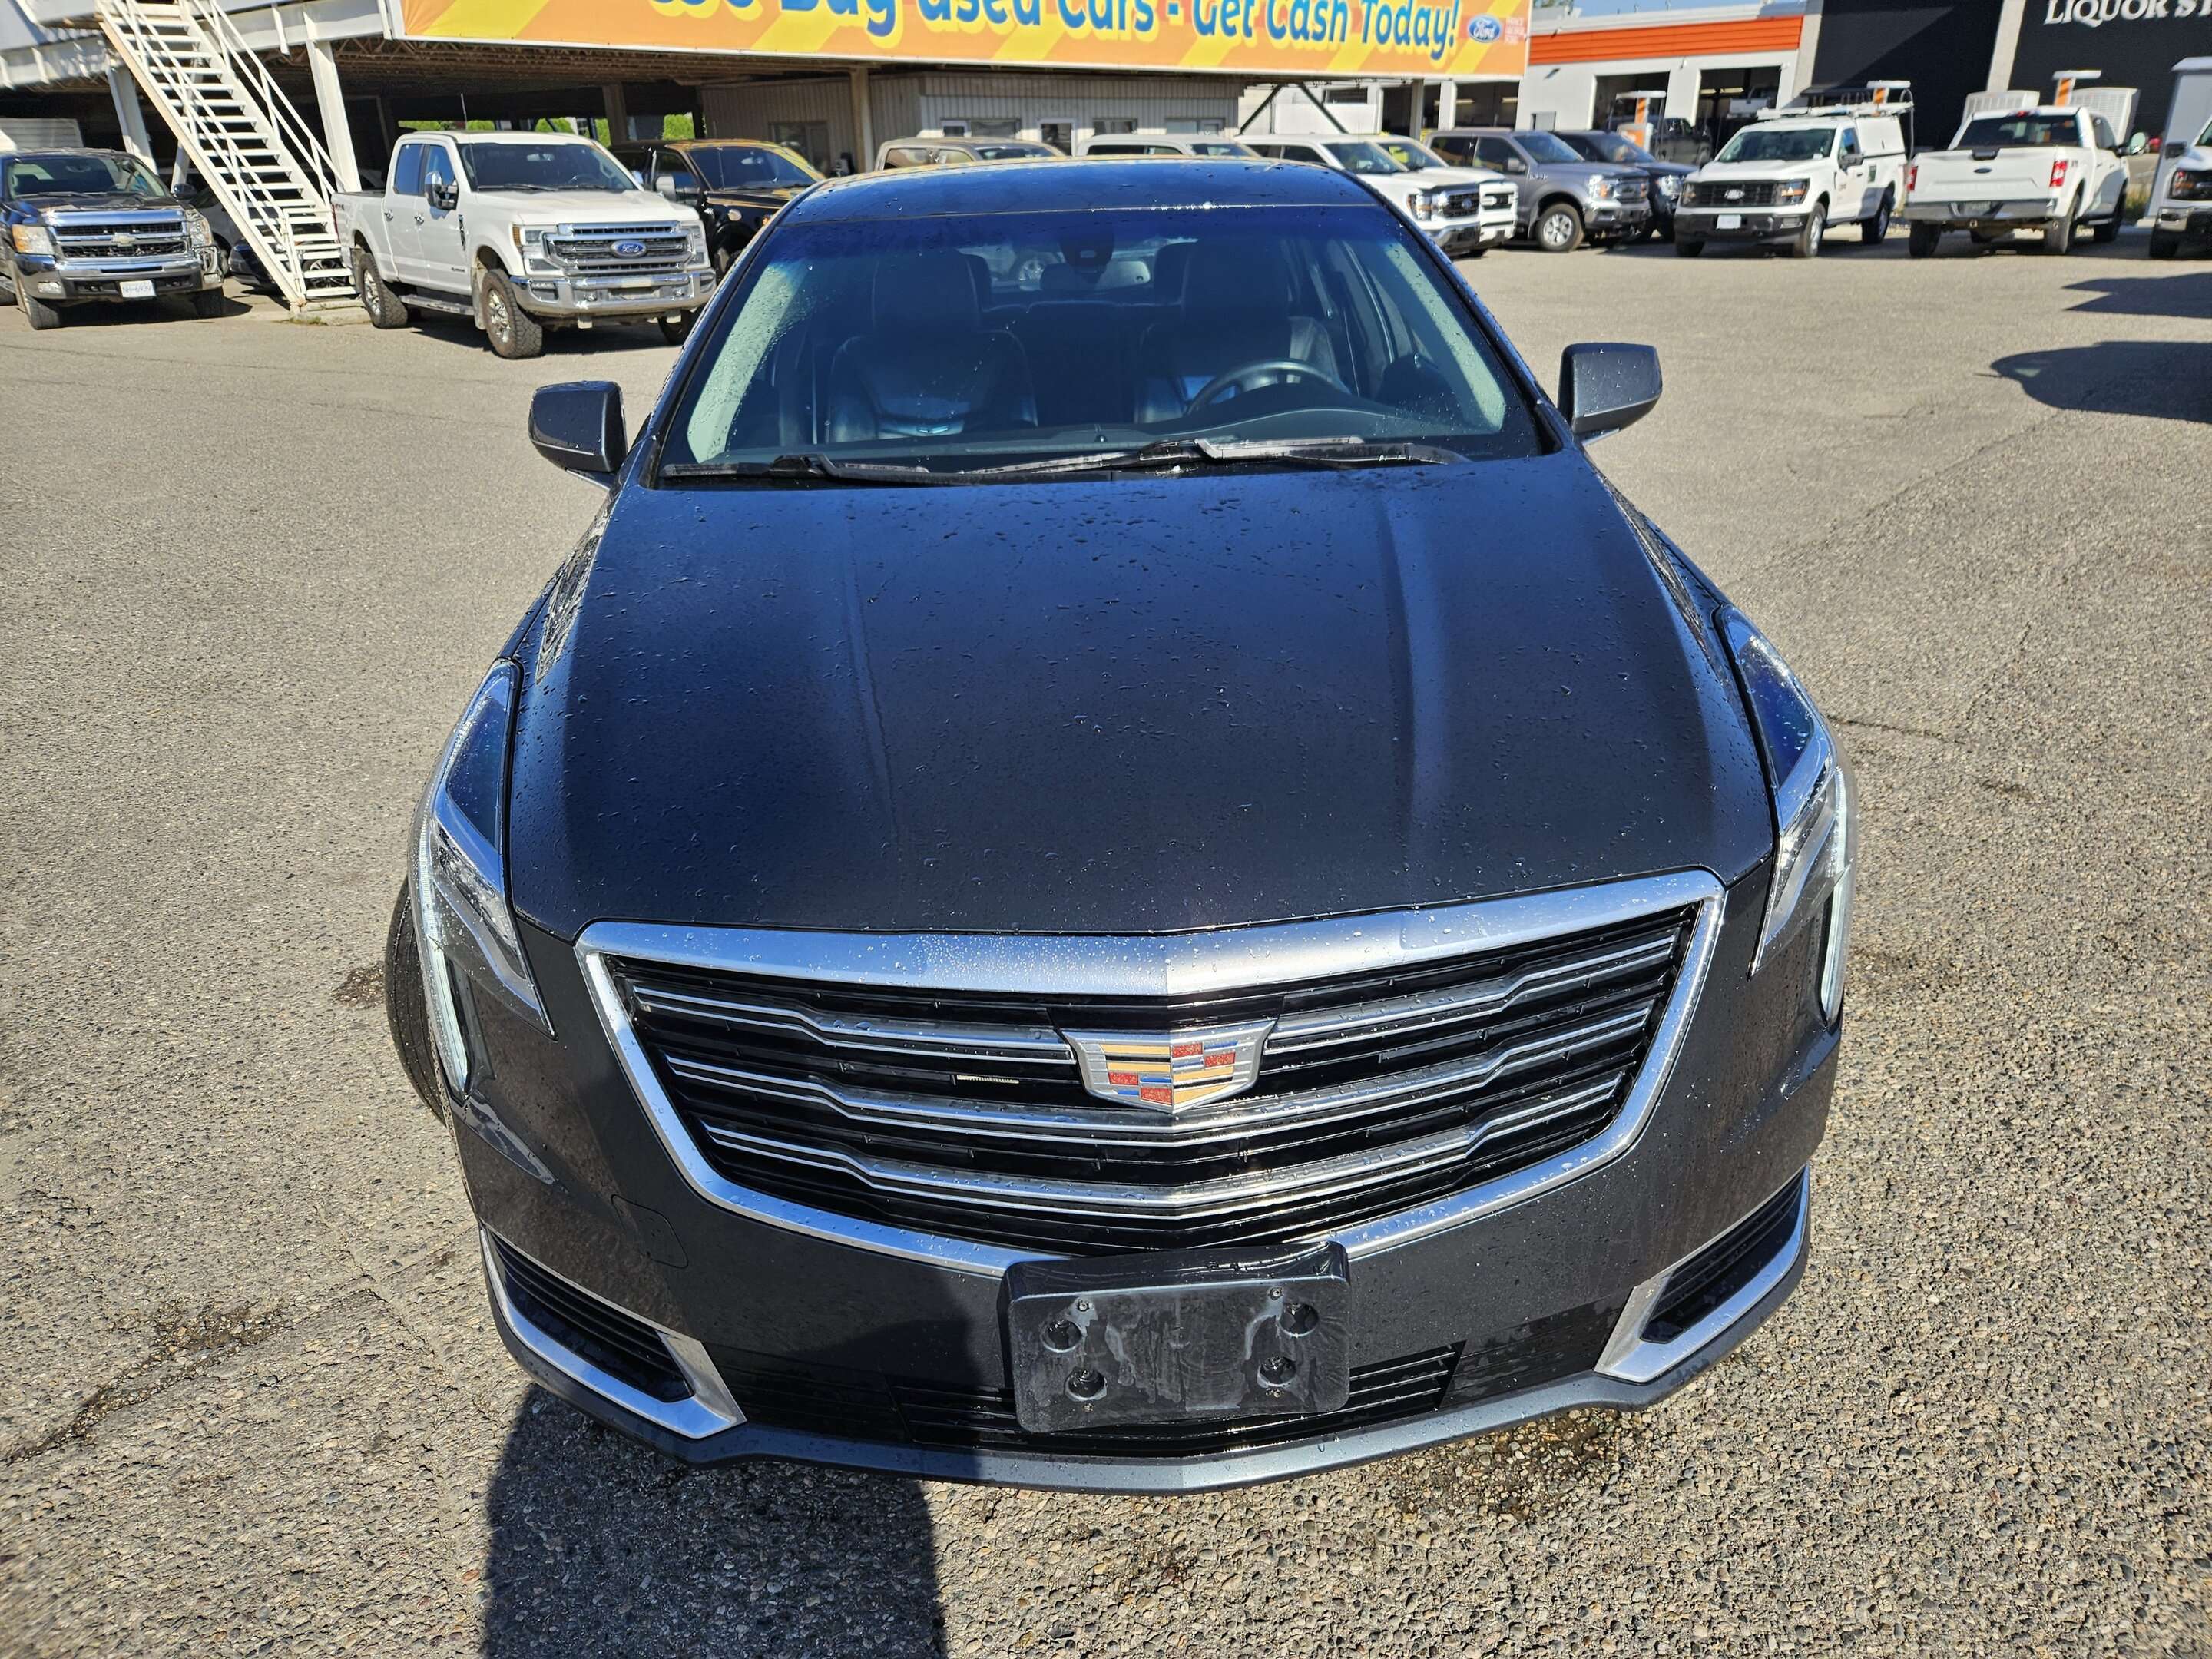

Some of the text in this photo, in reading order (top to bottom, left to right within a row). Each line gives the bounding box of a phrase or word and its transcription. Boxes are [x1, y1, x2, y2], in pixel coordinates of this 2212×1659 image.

[781, 0, 896, 37] uy
[1058, 0, 1154, 32] Cars
[1193, 0, 1253, 38] Get
[1268, 0, 1345, 43] Cash
[1362, 0, 1459, 60] Today!
[2044, 0, 2169, 28] LIQUOR
